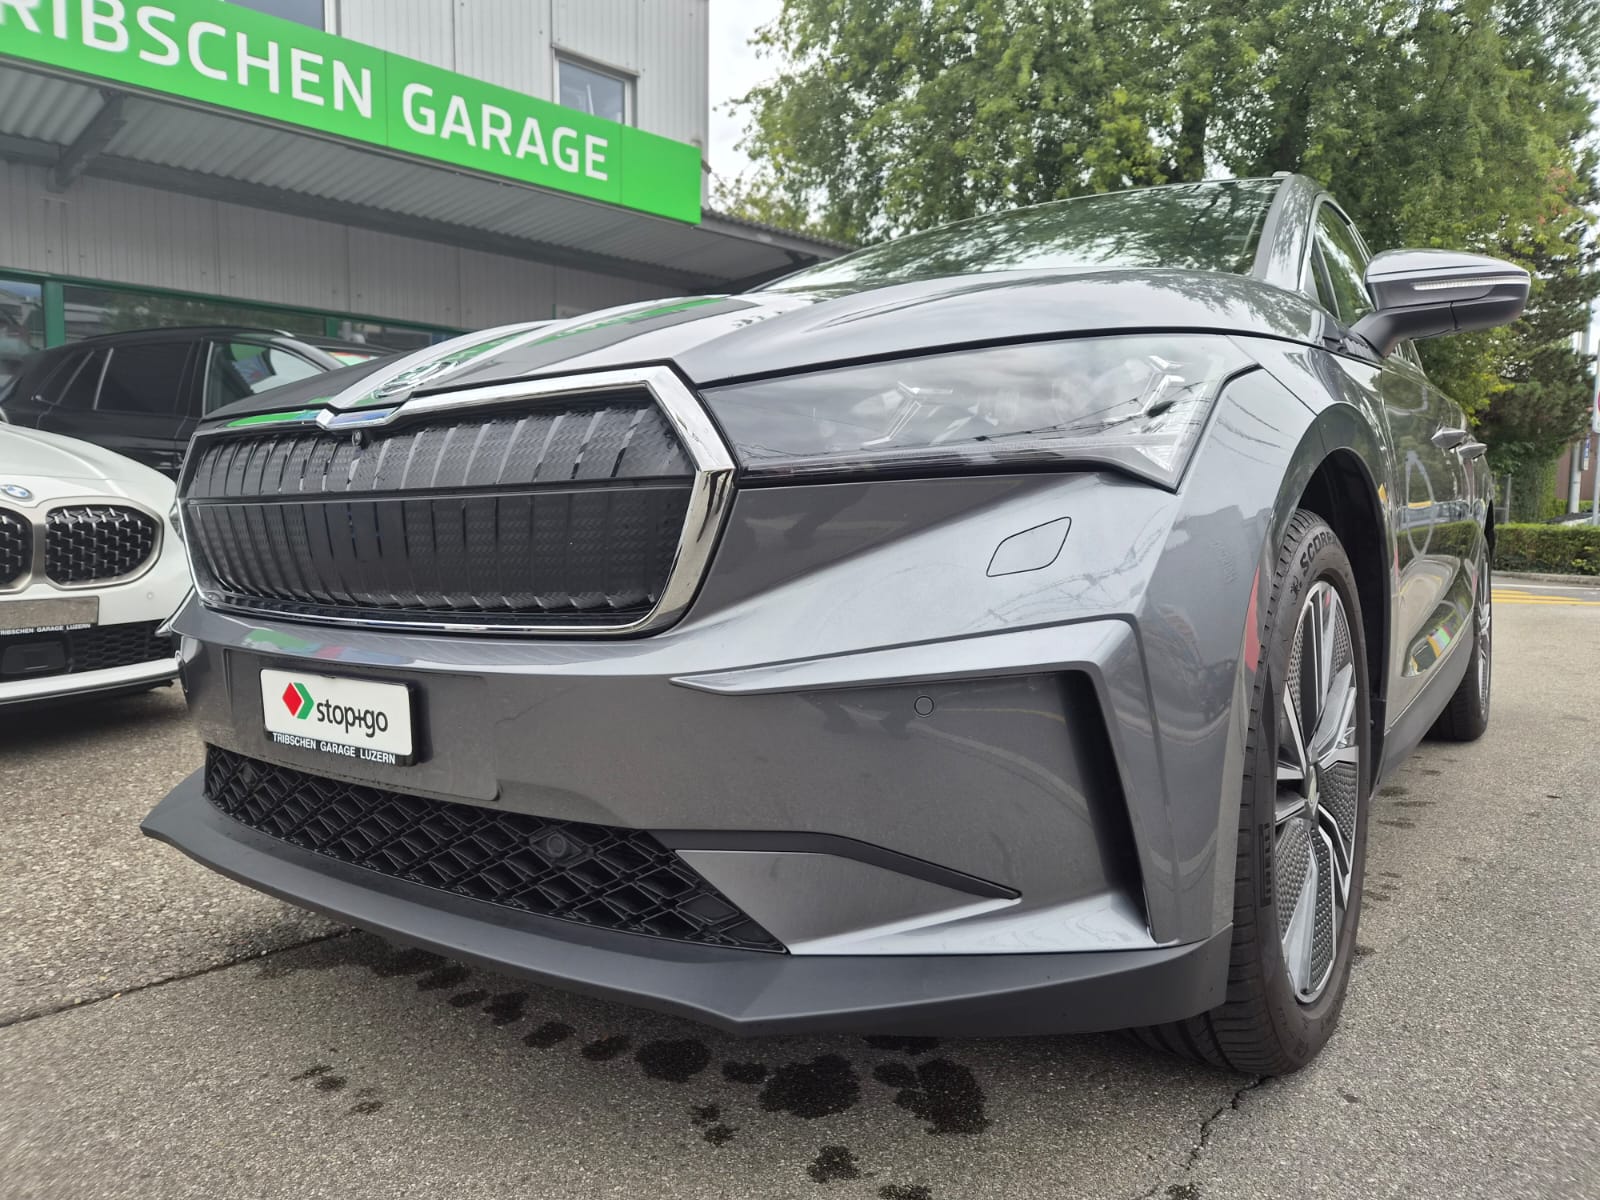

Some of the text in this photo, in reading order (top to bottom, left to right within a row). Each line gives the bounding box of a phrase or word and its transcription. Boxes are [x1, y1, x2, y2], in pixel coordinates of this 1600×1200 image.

[402, 83, 608, 181] GARAGE
[316, 699, 388, 738] stop+go
[272, 732, 396, 764] TRIBSCHEN GARAGE LUZERN
